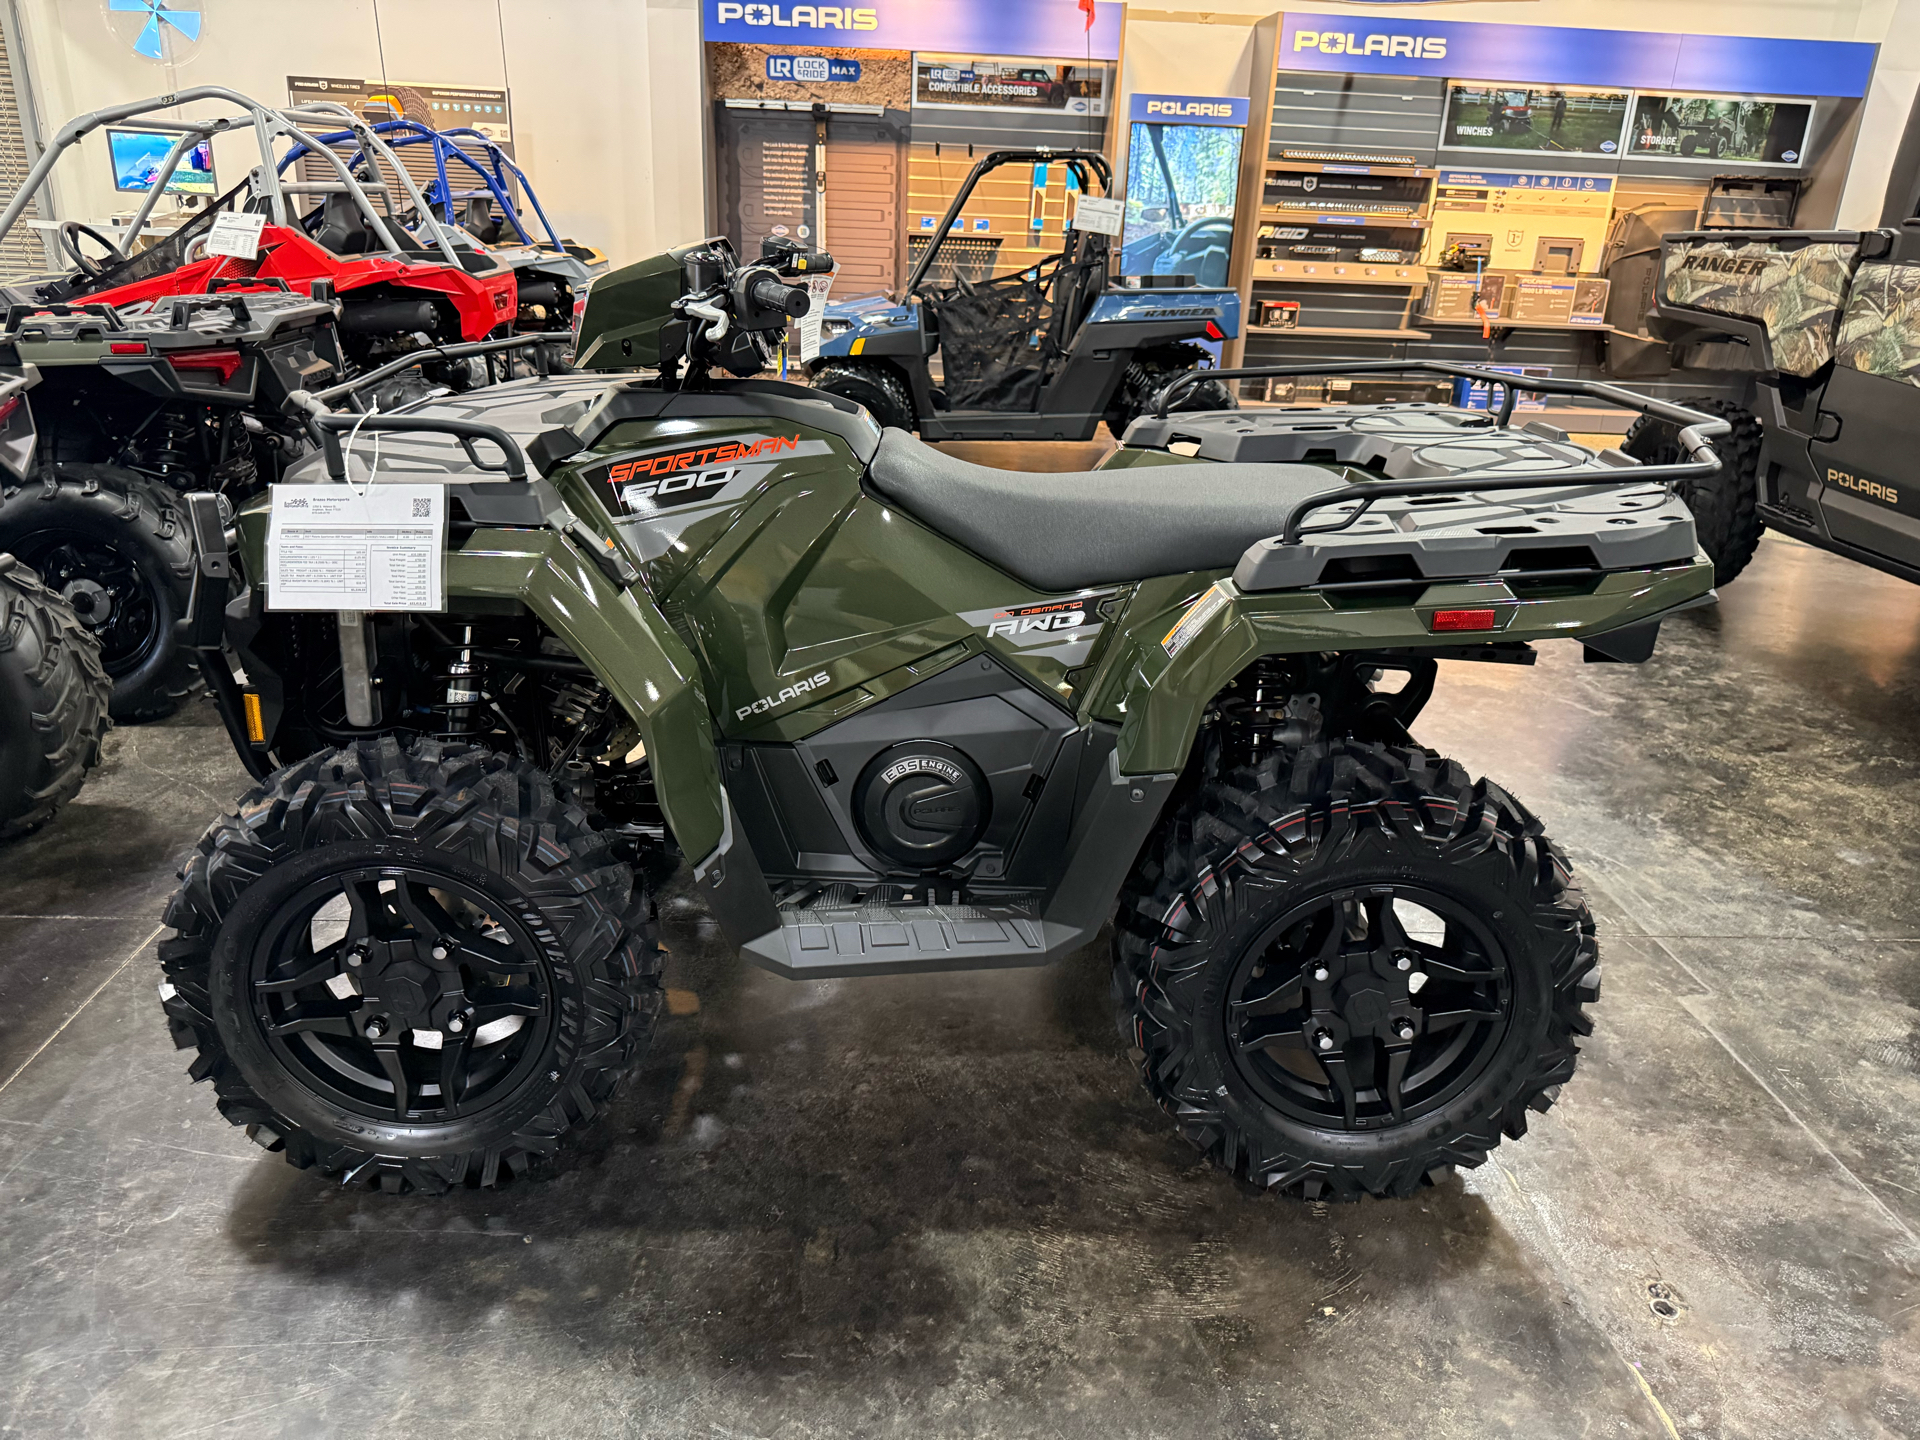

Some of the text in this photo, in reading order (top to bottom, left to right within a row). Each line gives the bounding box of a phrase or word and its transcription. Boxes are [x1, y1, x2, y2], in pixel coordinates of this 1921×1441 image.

[718, 2, 878, 31] POLARIS
[1293, 30, 1447, 59] POLARIS
[769, 58, 791, 78] LR
[797, 60, 826, 70] LOCK
[831, 66, 856, 76] MAX
[930, 68, 942, 80] LR
[928, 81, 1038, 97] COMPATIBLE ACCESSORIES
[1146, 100, 1233, 118] POLARIS
[1456, 124, 1494, 138] WINCHES
[1640, 134, 1678, 147] STORAGE
[1257, 225, 1310, 240] RIGID
[1681, 255, 1768, 277] RANGER
[1637, 267, 1652, 321] POLARIS
[1143, 307, 1217, 318] RANGER
[606, 433, 801, 483] SPORTSMAN
[1827, 467, 1898, 504] POLARIS
[1020, 601, 1083, 615] DEMAND
[986, 611, 1085, 638] AWD
[735, 670, 831, 721] POLARIS
[885, 760, 960, 781] EBS ENGINE
[913, 807, 961, 815] POLARIS
[502, 895, 579, 1069] POWER GRIP
